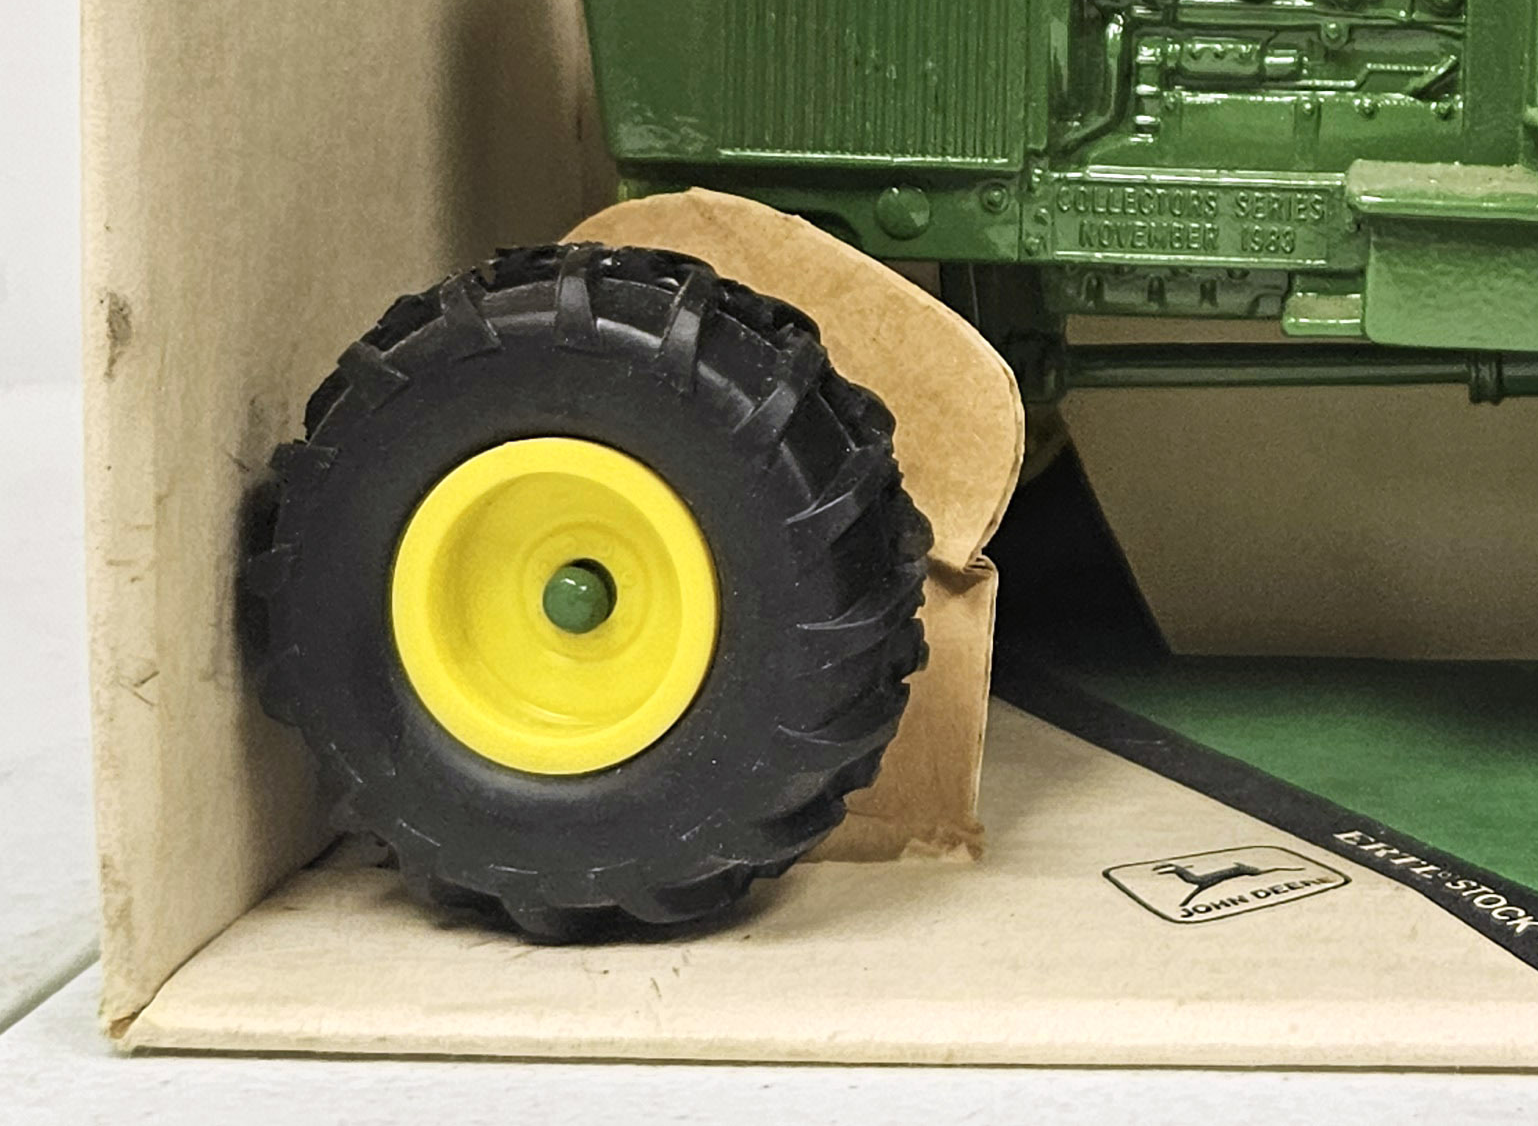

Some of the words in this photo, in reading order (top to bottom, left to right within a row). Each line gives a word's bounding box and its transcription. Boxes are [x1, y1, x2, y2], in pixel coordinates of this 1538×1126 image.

[1055, 186, 1218, 215] COLLECTORS
[1233, 191, 1325, 221] SERIES
[1077, 220, 1220, 251] NOVEMBER
[1180, 892, 1250, 919] JOHN
[1255, 875, 1336, 900] DEERE
